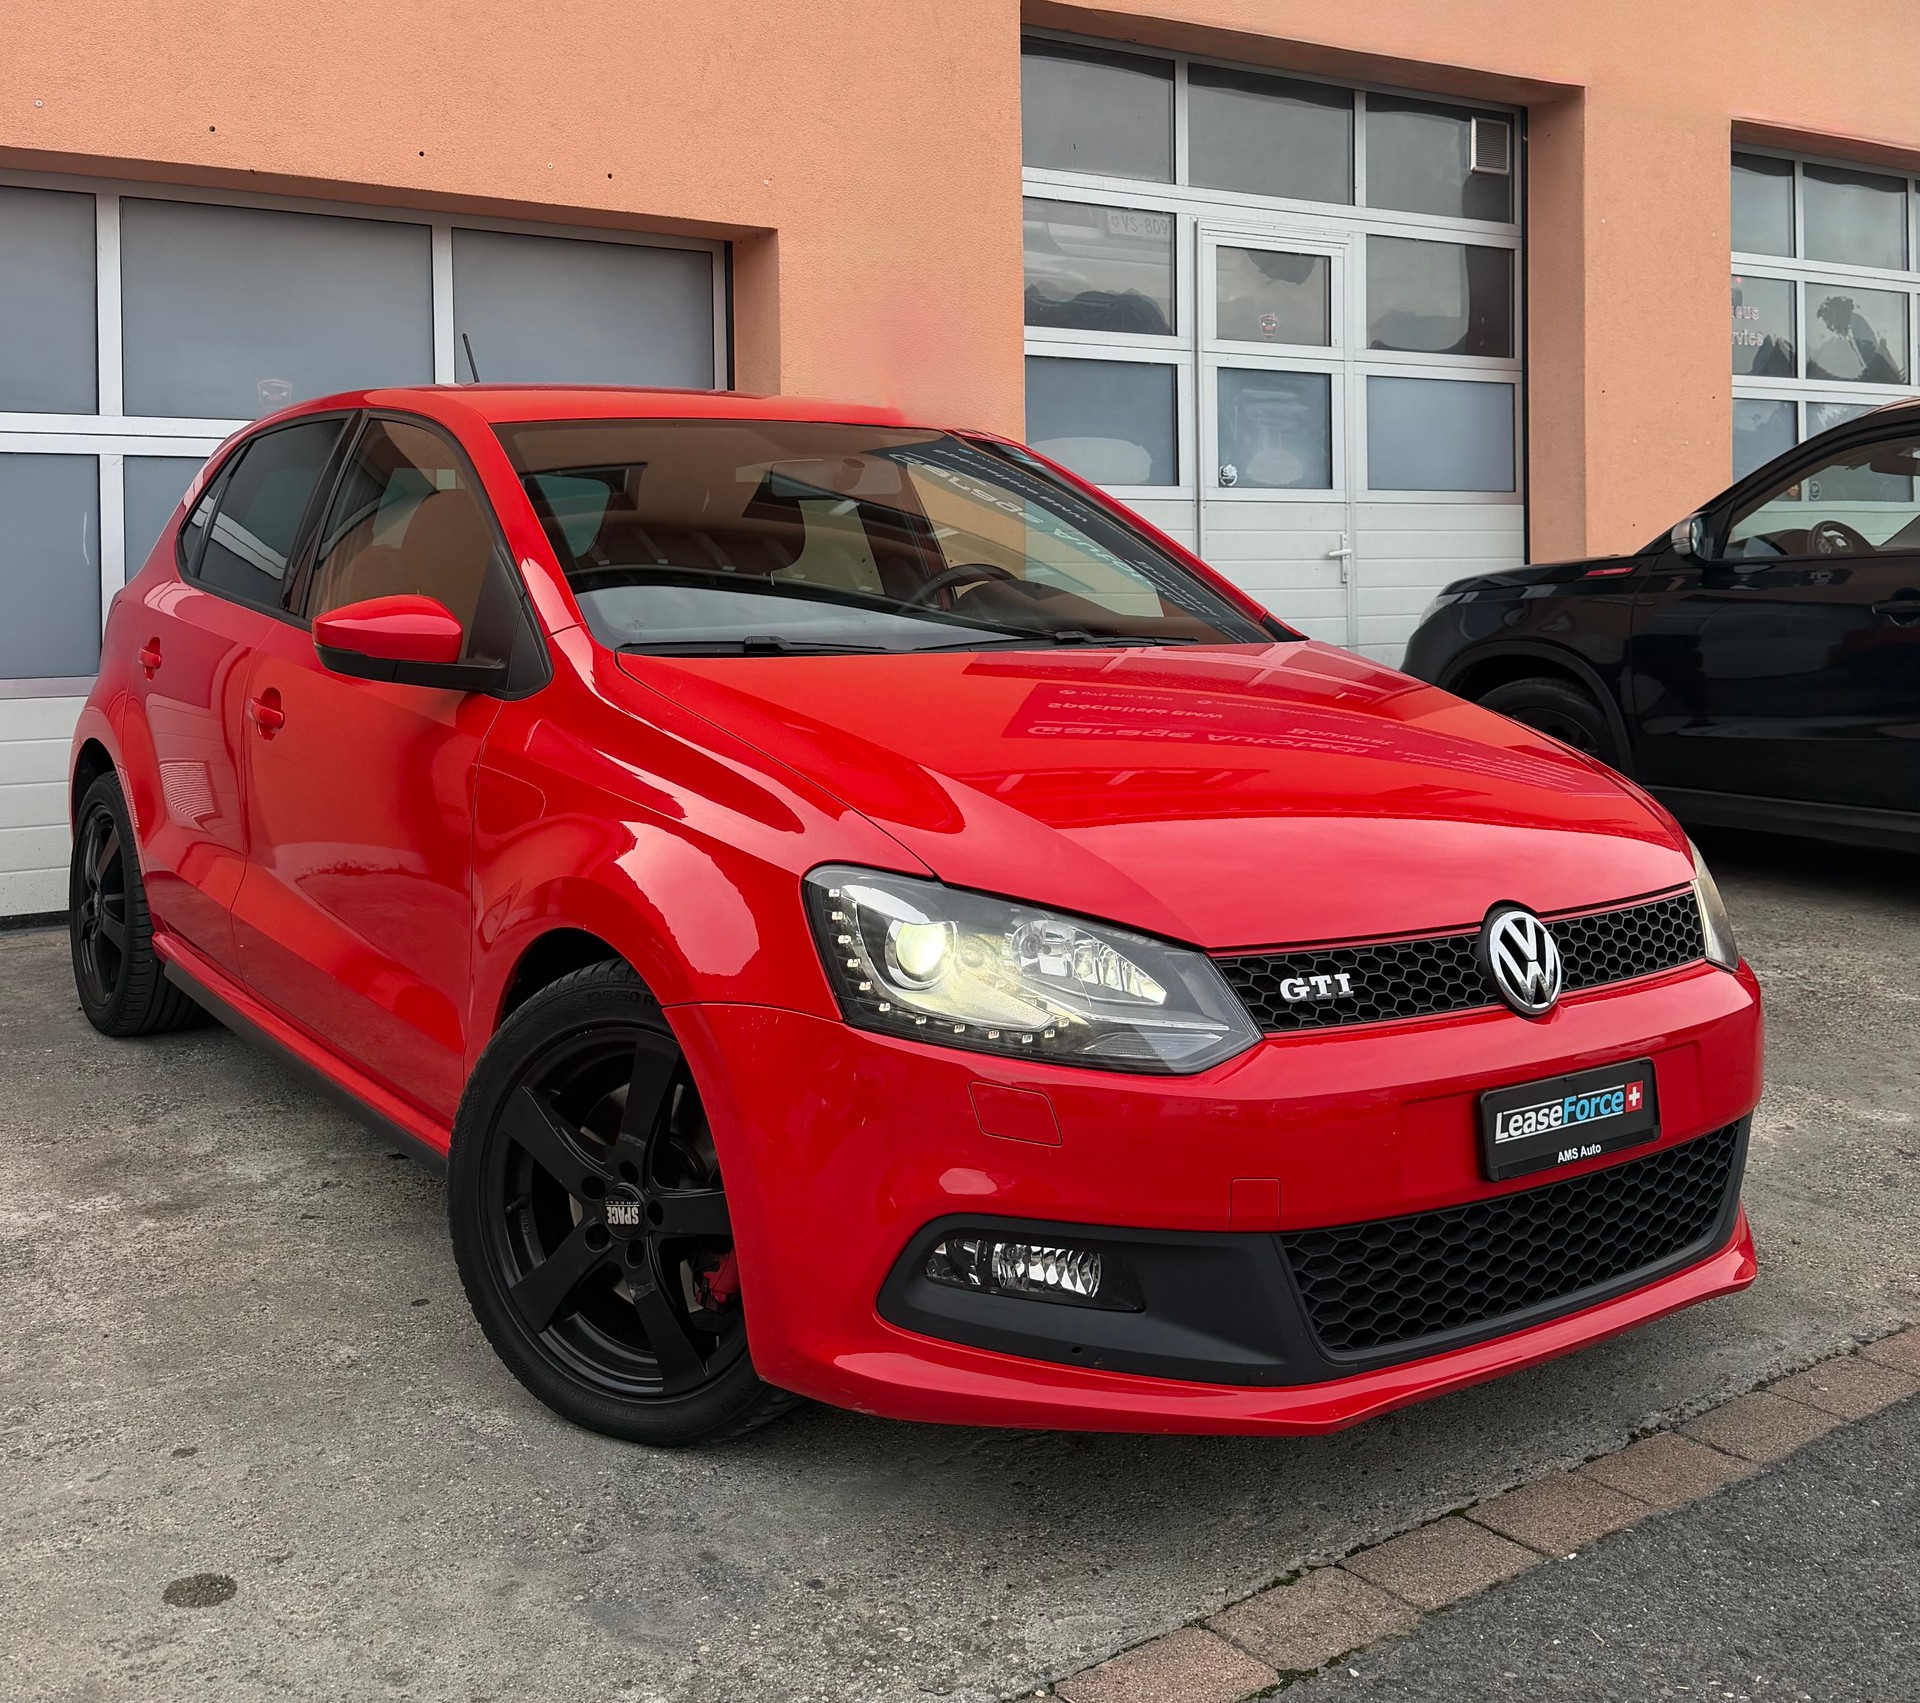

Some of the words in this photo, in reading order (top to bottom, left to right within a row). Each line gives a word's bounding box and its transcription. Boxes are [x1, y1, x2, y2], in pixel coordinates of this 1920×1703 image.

[1732, 305, 1759, 320] eus
[1280, 973, 1354, 1003] GTI
[1495, 1090, 1624, 1141] LeaseForce
[1557, 1148, 1579, 1164] AMS
[1580, 1143, 1602, 1159] Auto
[606, 1206, 640, 1225] SPACE
